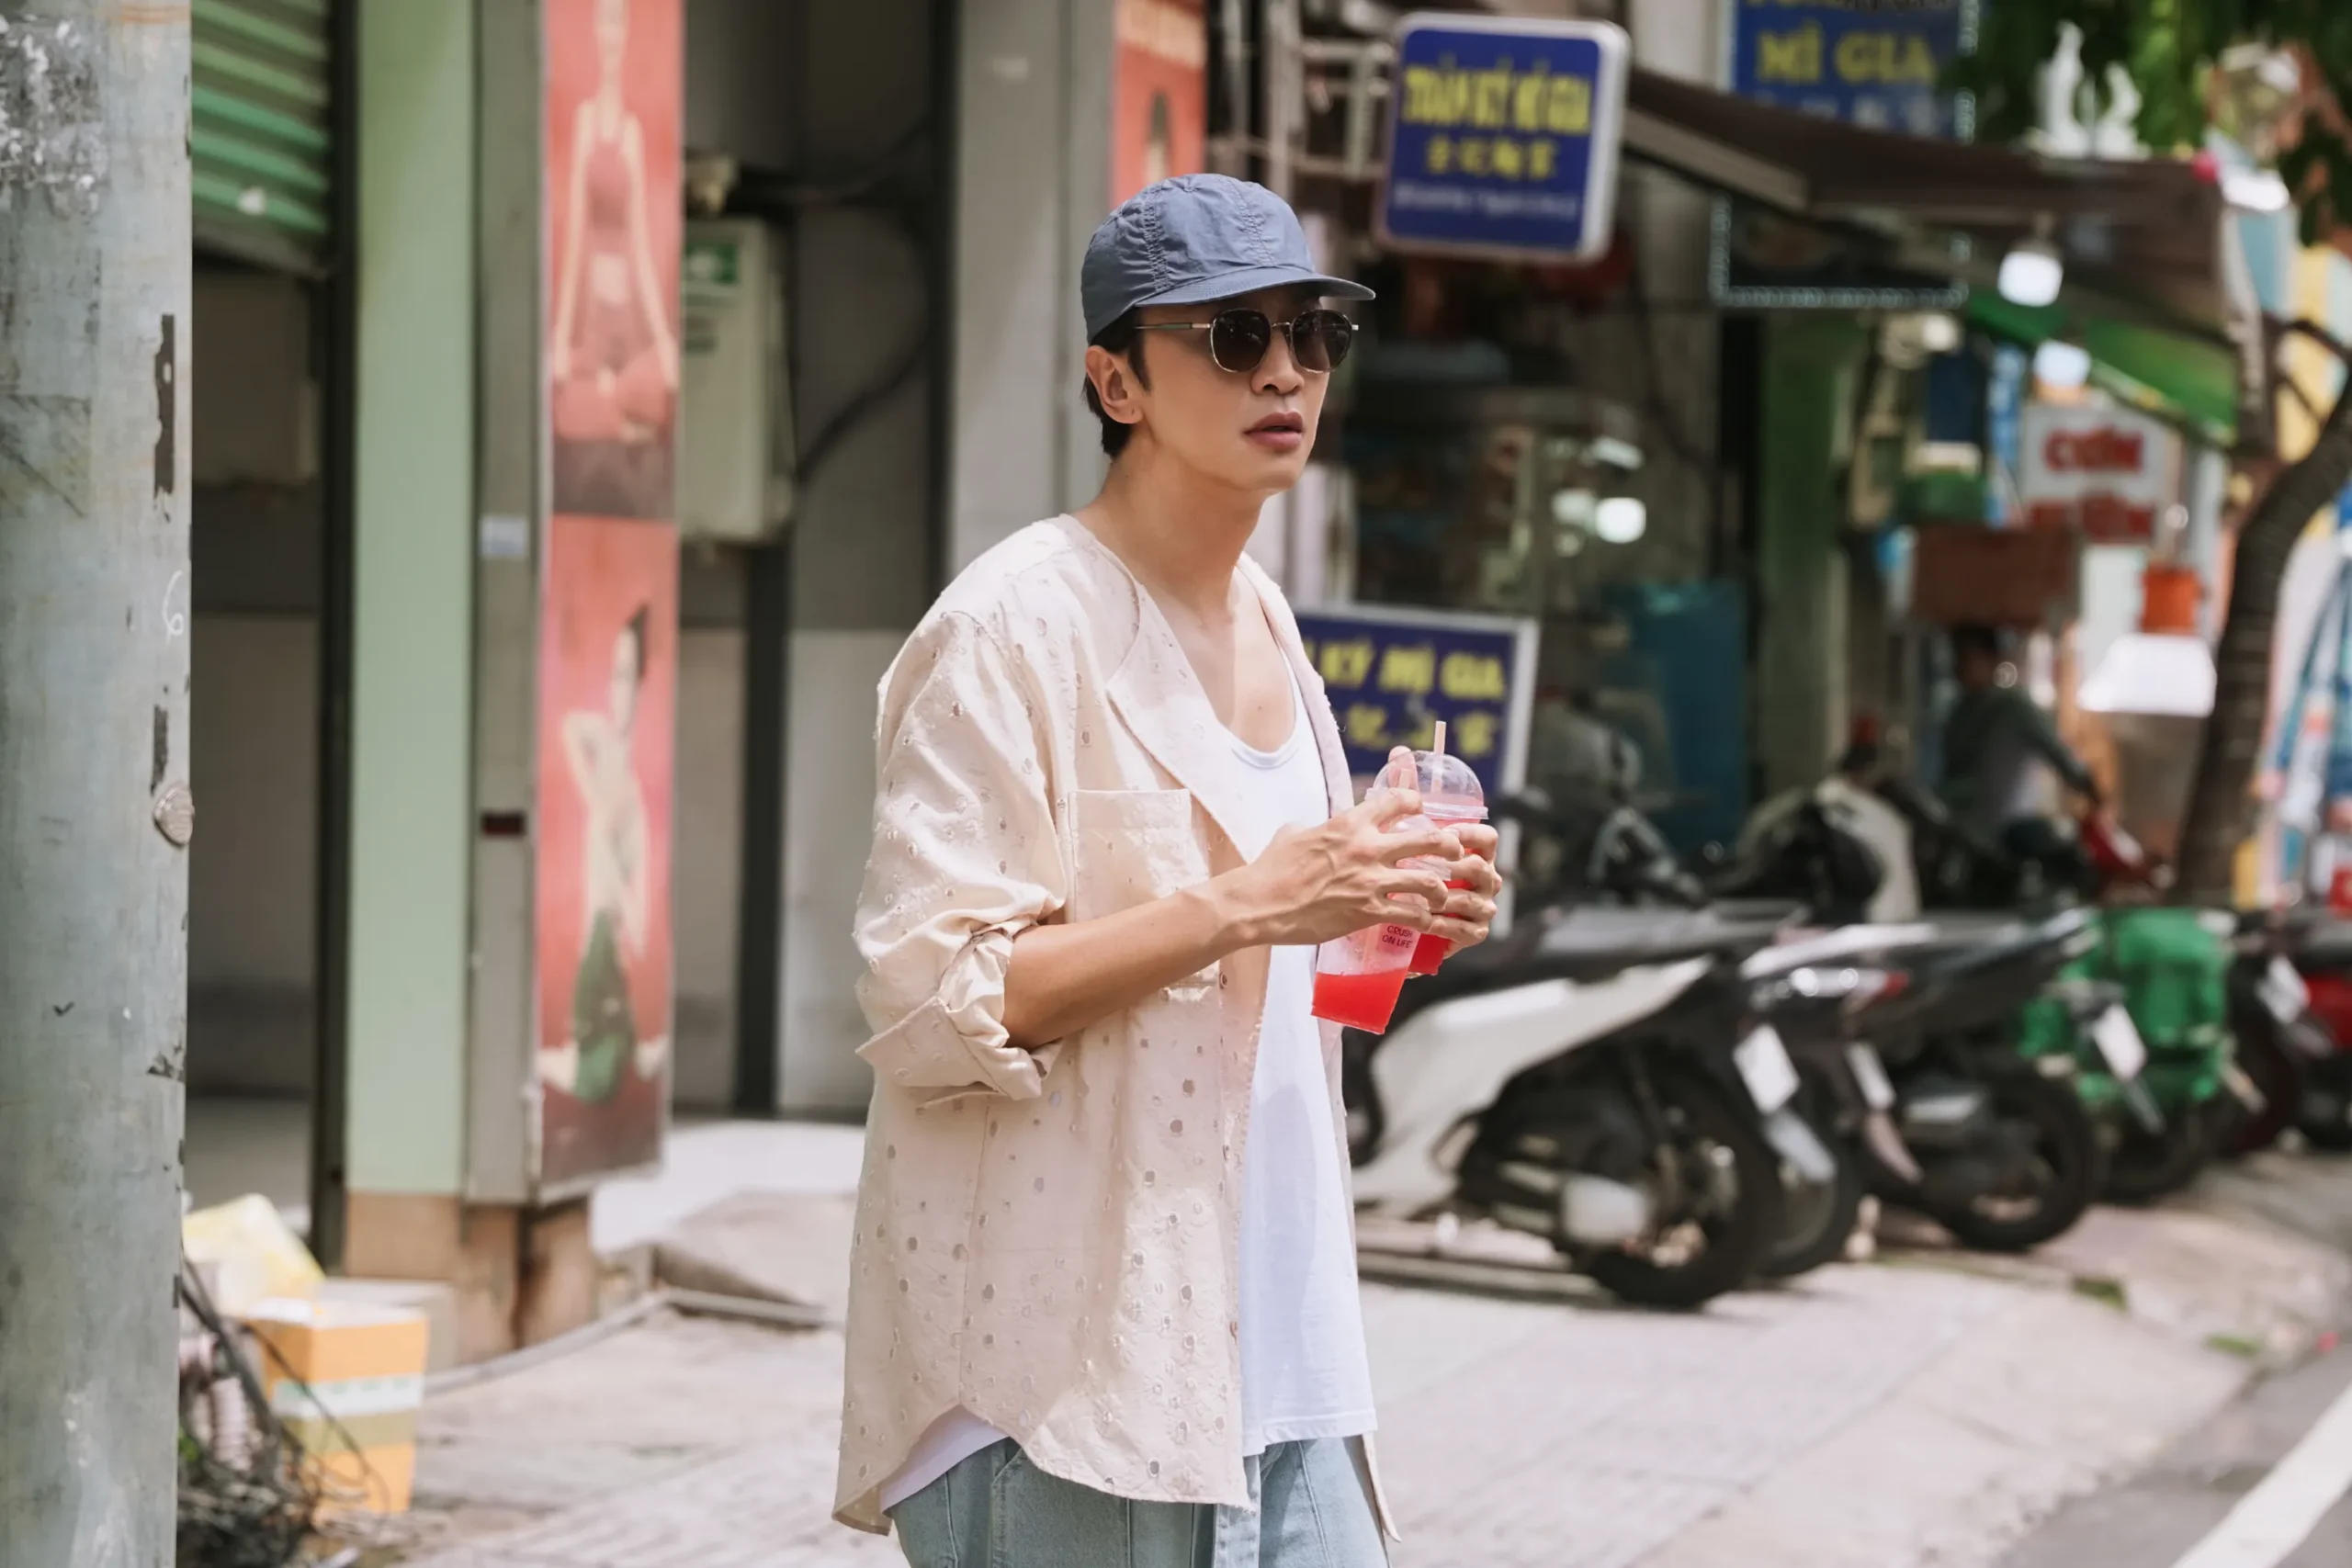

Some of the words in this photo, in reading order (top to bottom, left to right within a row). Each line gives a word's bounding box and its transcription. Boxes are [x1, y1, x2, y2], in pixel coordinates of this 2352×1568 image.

[1837, 32, 1938, 85] GIA
[1386, 925, 1413, 937] CRUSH
[1382, 934, 1396, 944] ON
[1396, 939, 1412, 948] LIFE
